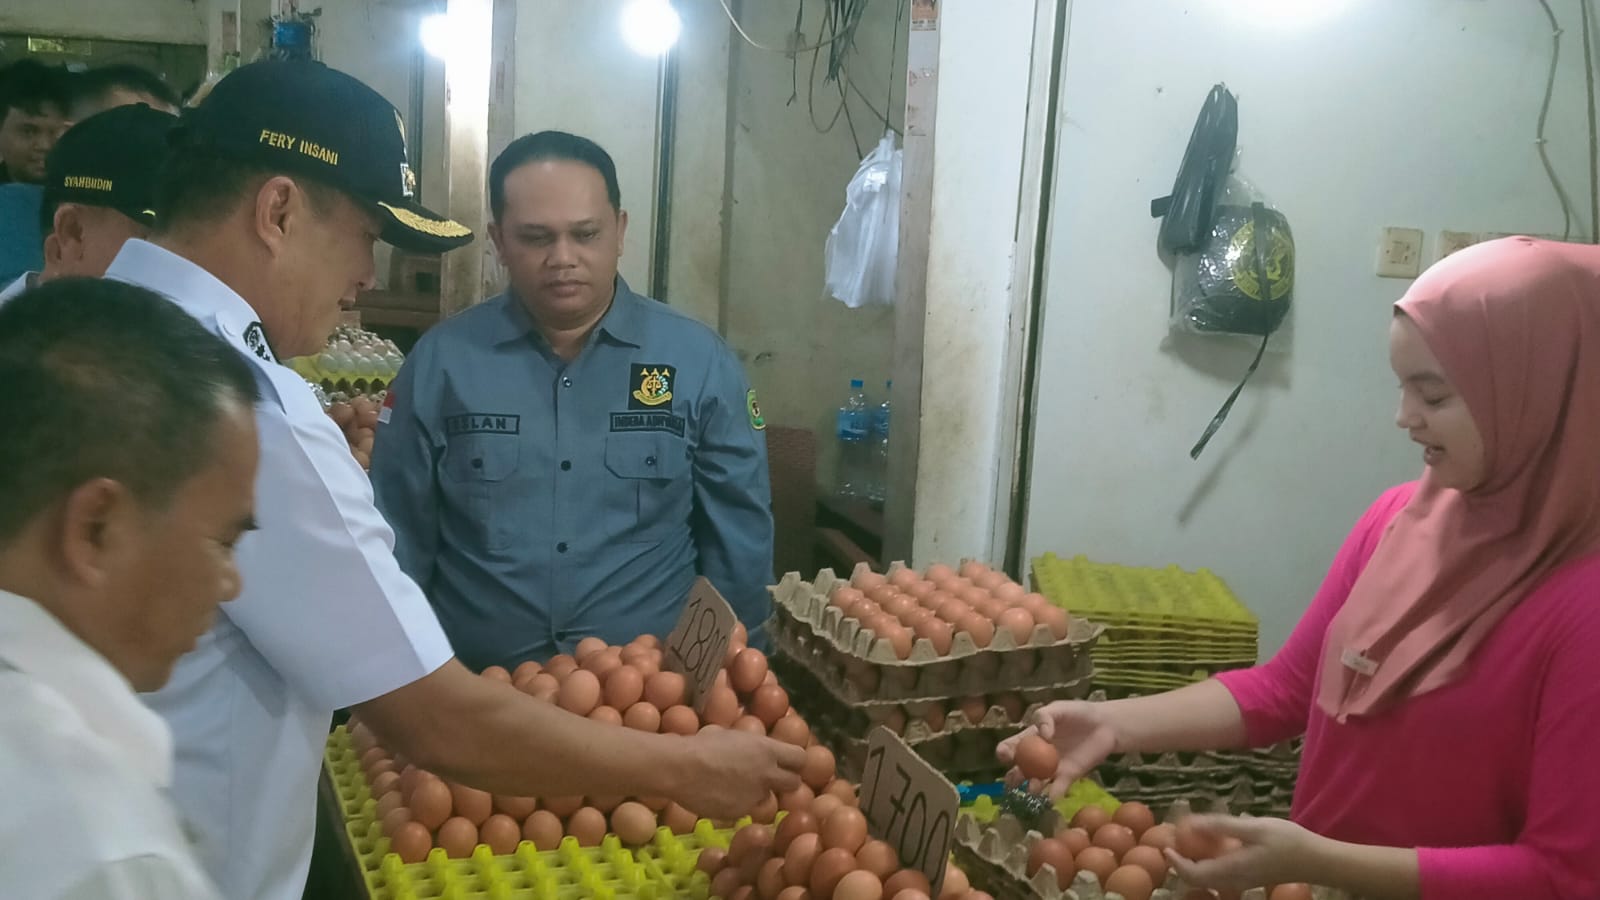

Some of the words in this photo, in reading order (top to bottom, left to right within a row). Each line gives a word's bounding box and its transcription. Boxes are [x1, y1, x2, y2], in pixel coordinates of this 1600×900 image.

[260, 129, 296, 150] FERY
[299, 139, 339, 166] INSANI
[64, 176, 113, 191] SYAHBUDIN
[869, 745, 950, 885] 1700
